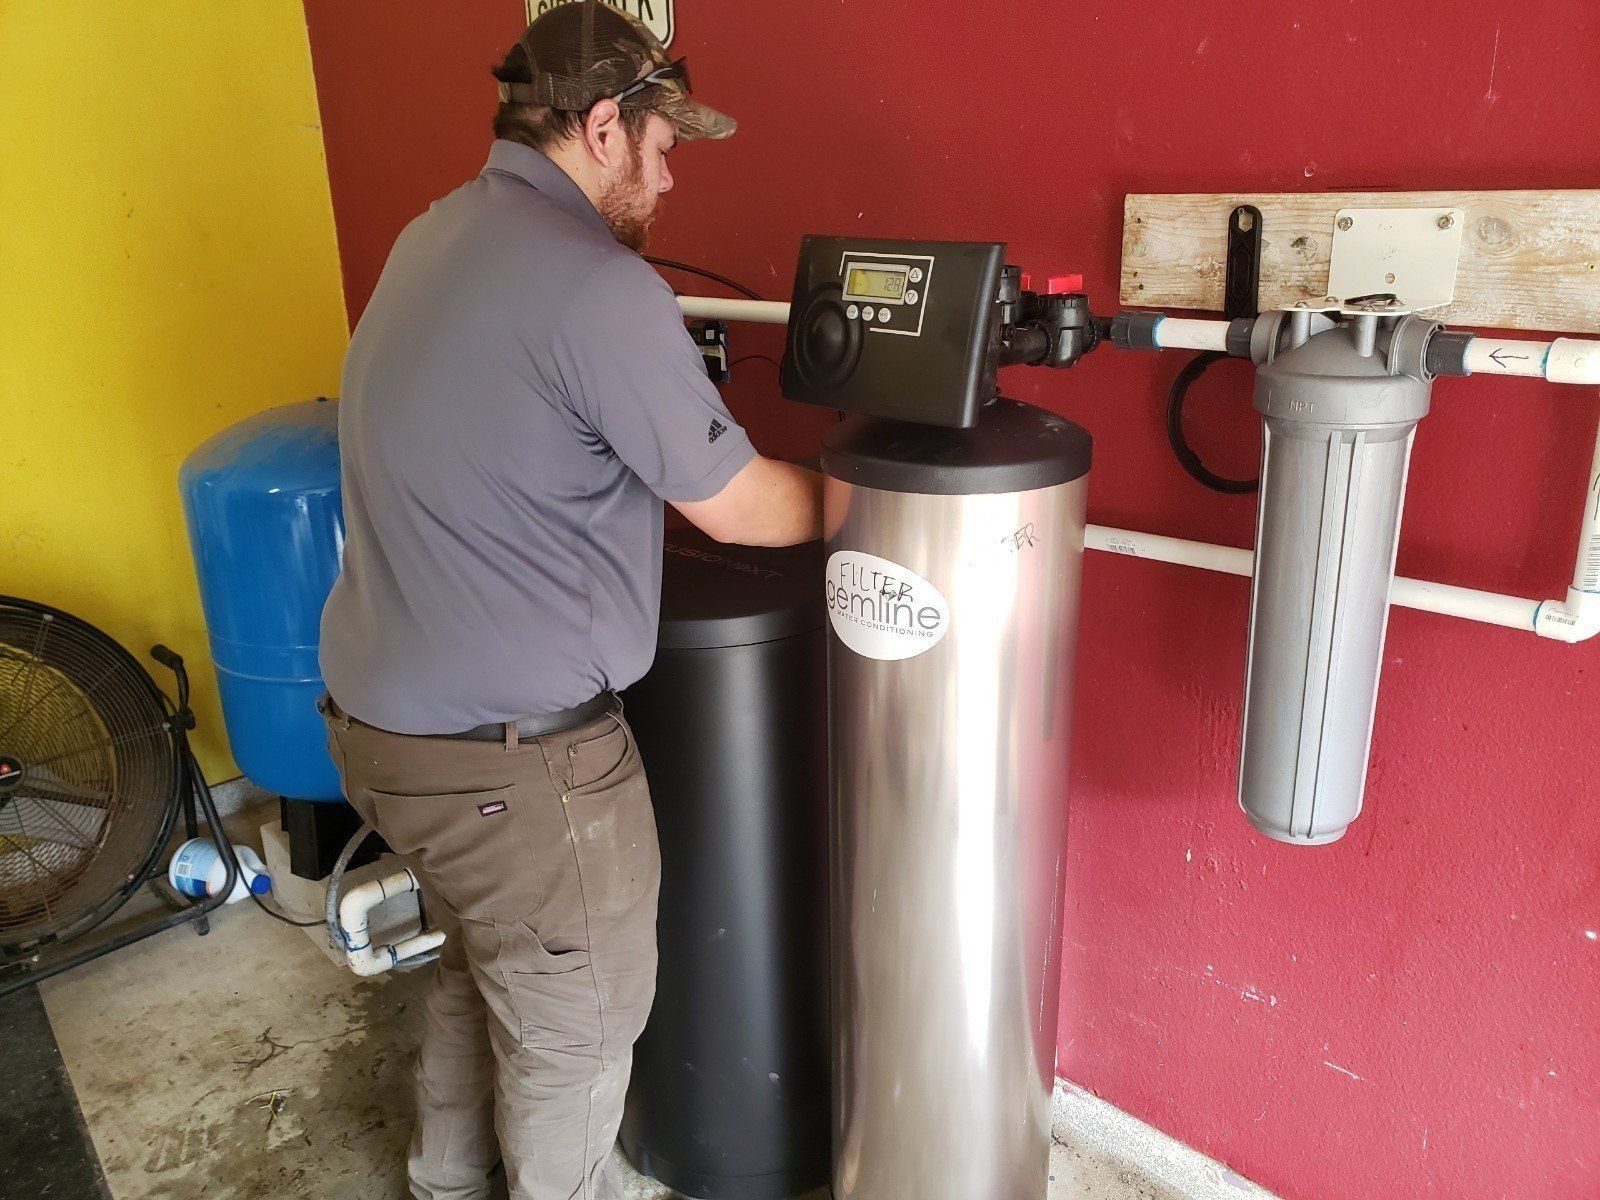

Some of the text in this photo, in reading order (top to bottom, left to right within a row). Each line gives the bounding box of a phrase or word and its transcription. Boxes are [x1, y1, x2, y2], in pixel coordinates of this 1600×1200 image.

[1289, 400, 1315, 413] NPT
[708, 425, 728, 444] adidas
[840, 561, 914, 602] FILTER
[827, 580, 941, 630] gemline
[836, 610, 934, 638] WATER CONDITIONING
